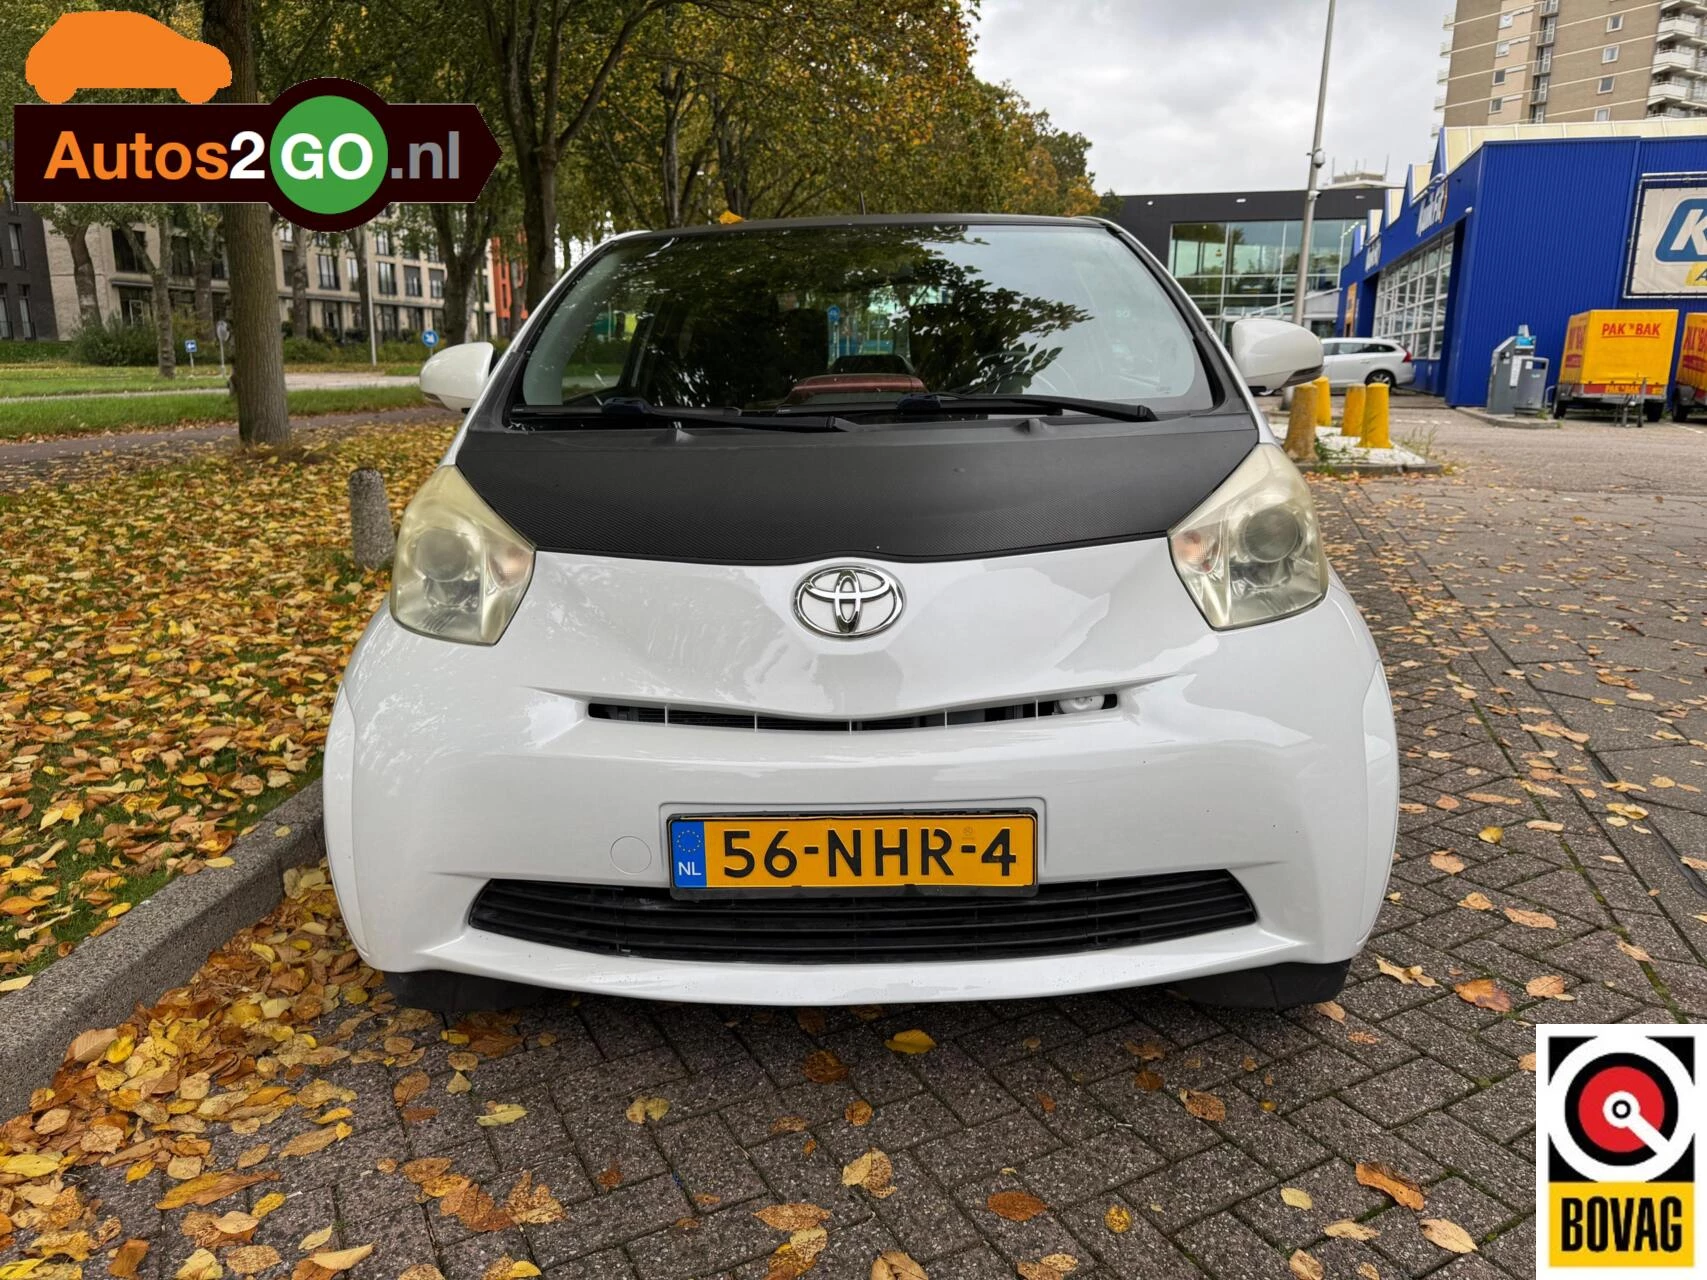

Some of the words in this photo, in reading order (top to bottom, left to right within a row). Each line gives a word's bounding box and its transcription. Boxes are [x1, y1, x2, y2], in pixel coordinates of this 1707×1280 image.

[1602, 323, 1626, 336] PAK
[1635, 323, 1662, 336] BAK
[722, 828, 1017, 879] 56-NHR-4
[678, 861, 702, 877] NL
